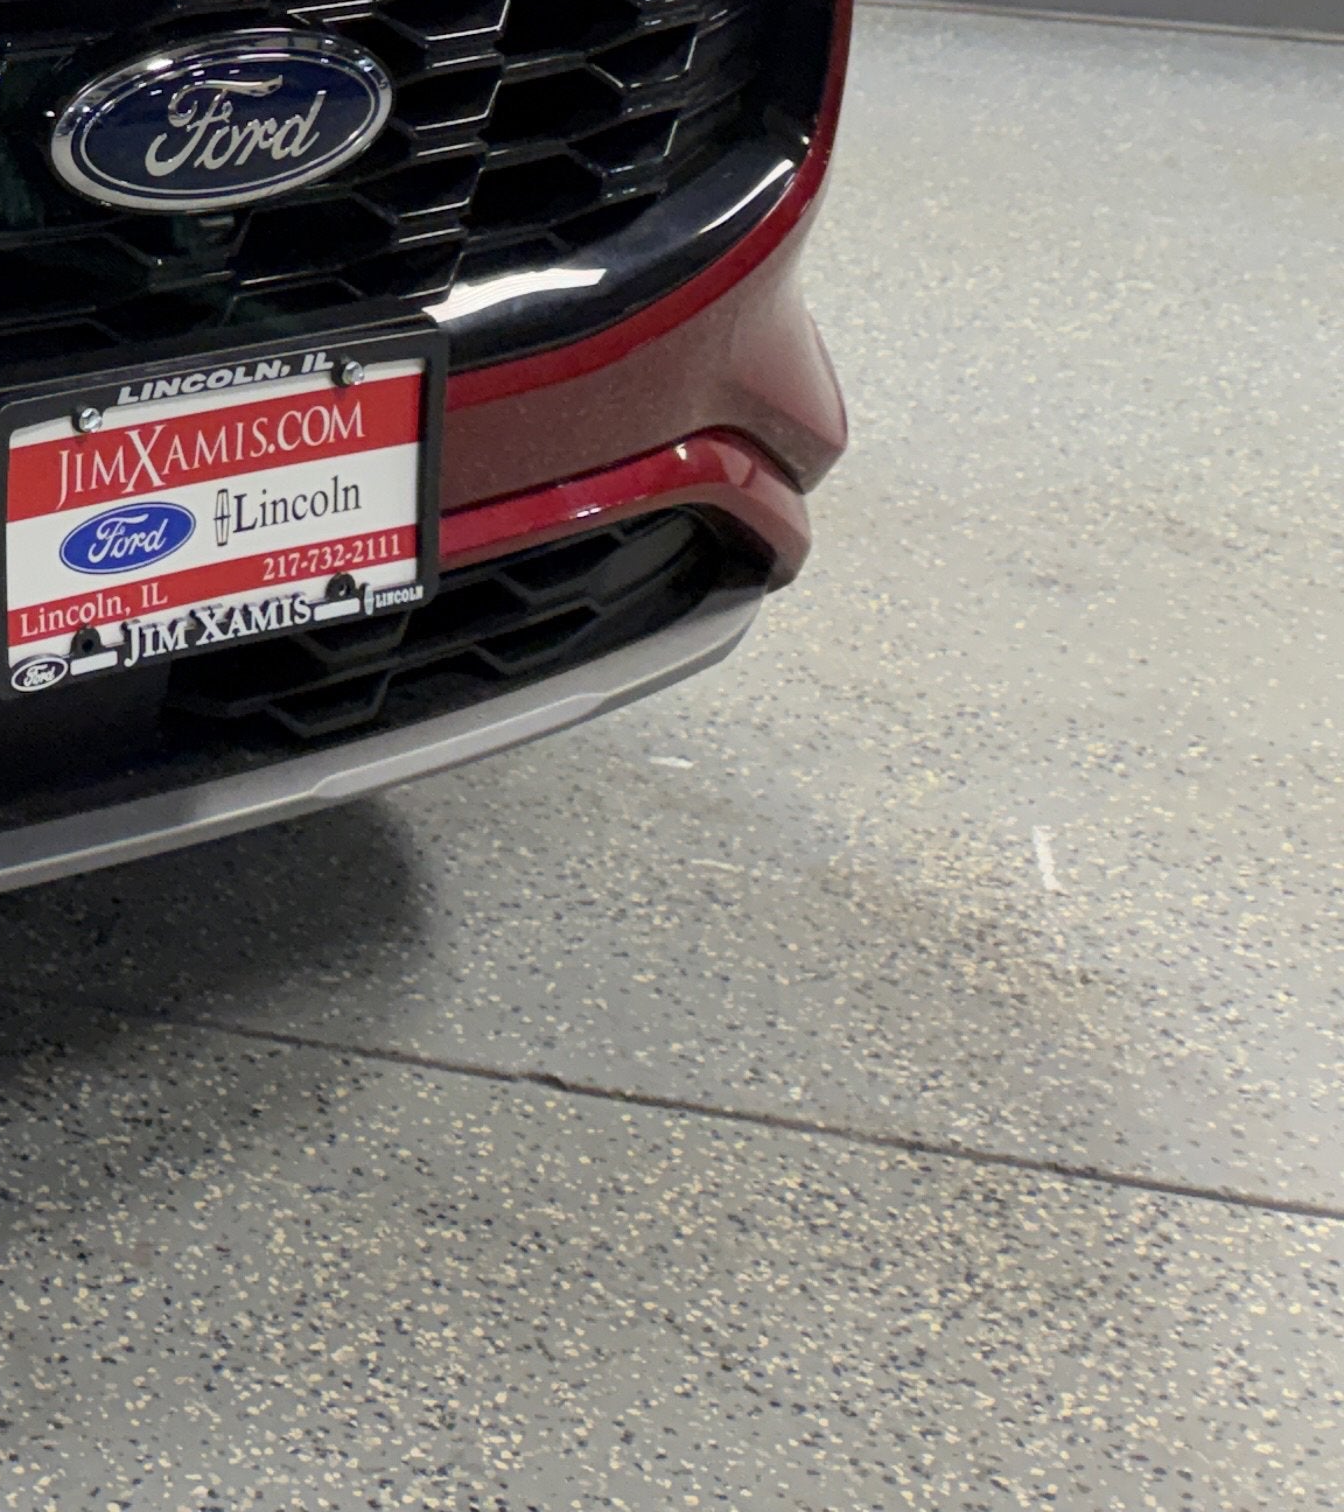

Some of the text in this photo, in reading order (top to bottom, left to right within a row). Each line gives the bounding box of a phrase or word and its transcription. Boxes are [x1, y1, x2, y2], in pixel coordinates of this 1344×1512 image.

[145, 74, 326, 177] Ford
[116, 351, 334, 406] LINCOLN, IL
[55, 400, 366, 511] JIMXAMIS.COM
[232, 474, 362, 534] Lincoln
[87, 513, 169, 564] Ford
[262, 533, 401, 582] 217-732-2111
[20, 581, 169, 638] Lincoln, IL
[123, 594, 313, 668] JIM XAMIS
[23, 663, 57, 688] Ford
